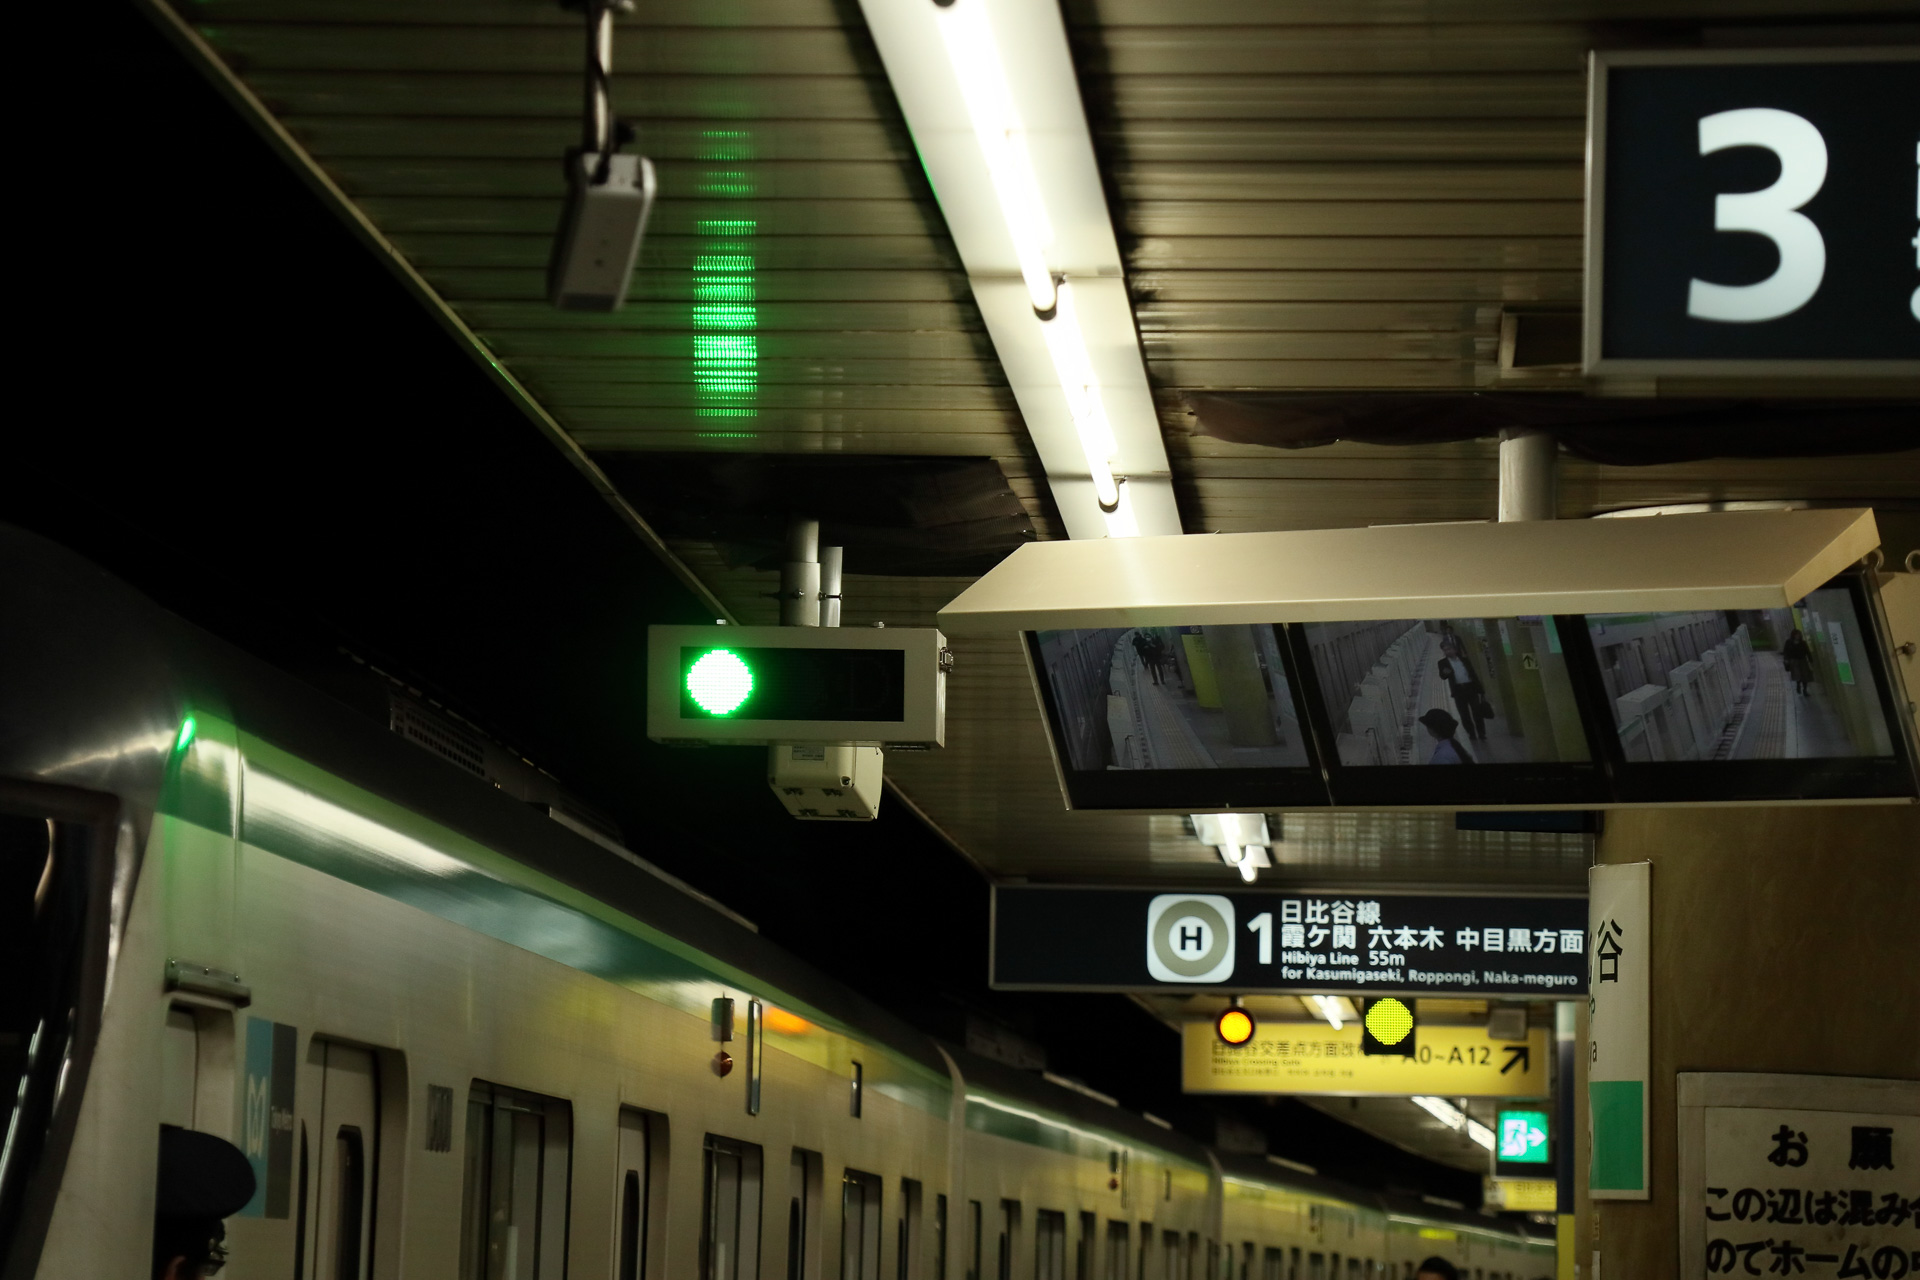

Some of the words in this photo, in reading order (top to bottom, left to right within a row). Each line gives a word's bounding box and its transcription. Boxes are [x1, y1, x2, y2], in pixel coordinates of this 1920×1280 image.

[1687, 107, 1829, 323] 3
[1281, 899, 1381, 925] 日比谷線
[1180, 926, 1202, 951] H
[1247, 912, 1273, 965] 1
[1367, 925, 1444, 951] 六本木
[1456, 926, 1585, 954] 中目黒方面
[1590, 918, 1623, 984] 谷
[1281, 951, 1327, 967] Hibiya
[1330, 952, 1360, 966] Line
[1369, 950, 1406, 966] 55m
[1281, 967, 1303, 980] for
[1306, 968, 1405, 984] Kasumigaseki,
[1408, 969, 1480, 987] Roppongi,
[1483, 971, 1578, 988] Naka-meguro
[1706, 1237, 1920, 1280] のでホームの
